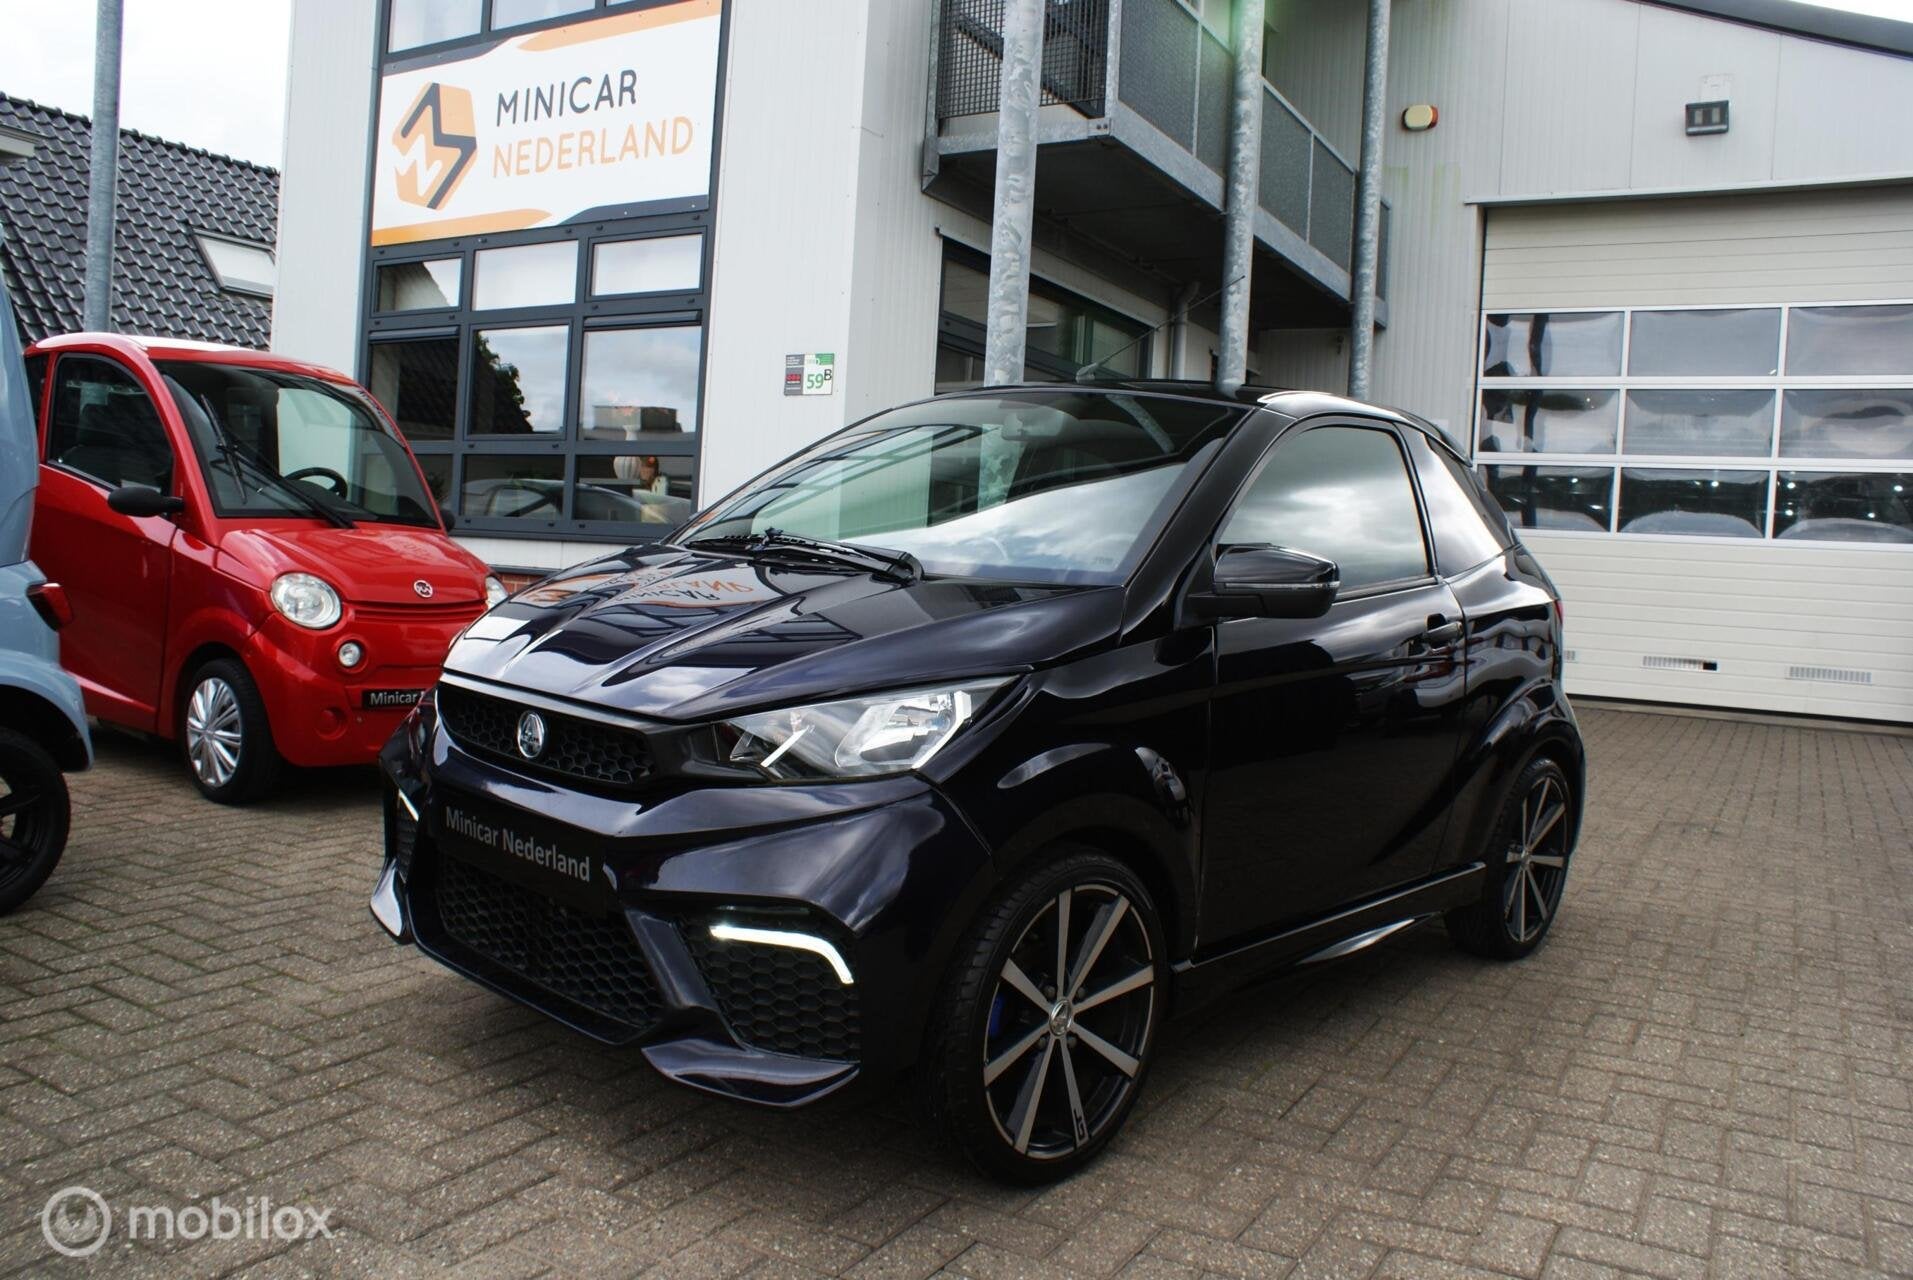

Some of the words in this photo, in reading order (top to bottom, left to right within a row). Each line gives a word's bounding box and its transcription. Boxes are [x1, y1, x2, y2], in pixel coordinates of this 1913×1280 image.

[496, 69, 637, 127] MINICAR
[493, 115, 694, 178] NEDERLAND
[370, 691, 418, 705] Minicar
[445, 806, 498, 847] Minicar
[502, 828, 591, 882] Nederland
